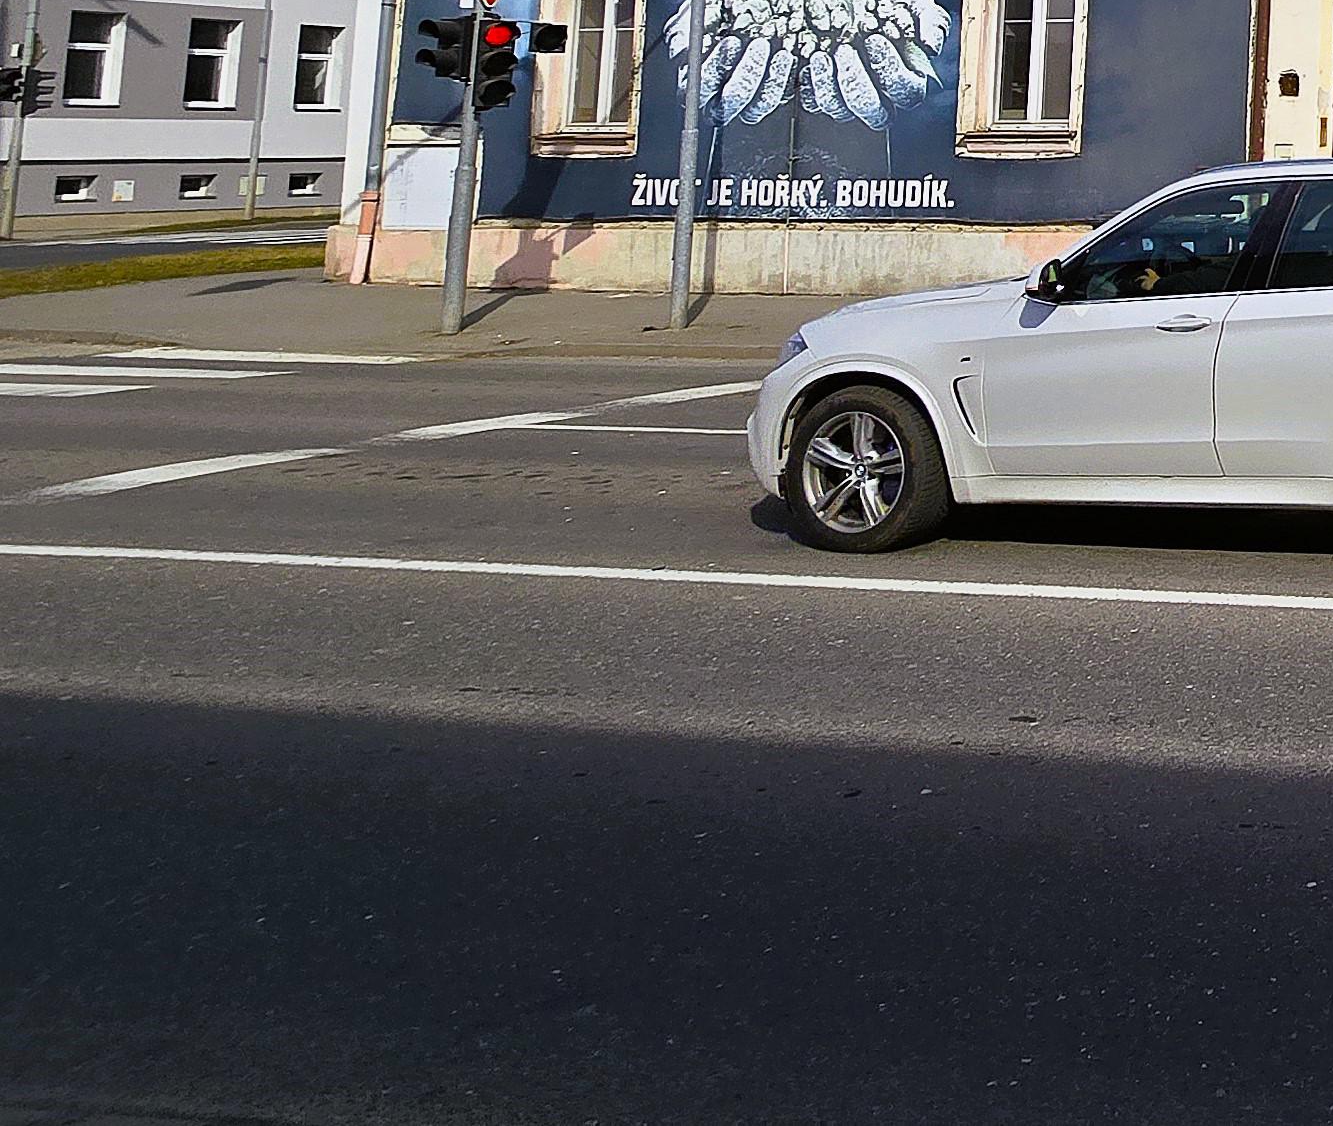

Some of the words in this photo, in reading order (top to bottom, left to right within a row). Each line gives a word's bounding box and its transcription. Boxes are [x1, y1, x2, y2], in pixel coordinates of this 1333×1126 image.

[631, 173, 703, 206] ŽIVO
[706, 178, 733, 206] JE
[741, 173, 828, 207] HOŘKÝ.
[836, 173, 955, 208] BOHUDÍK.
